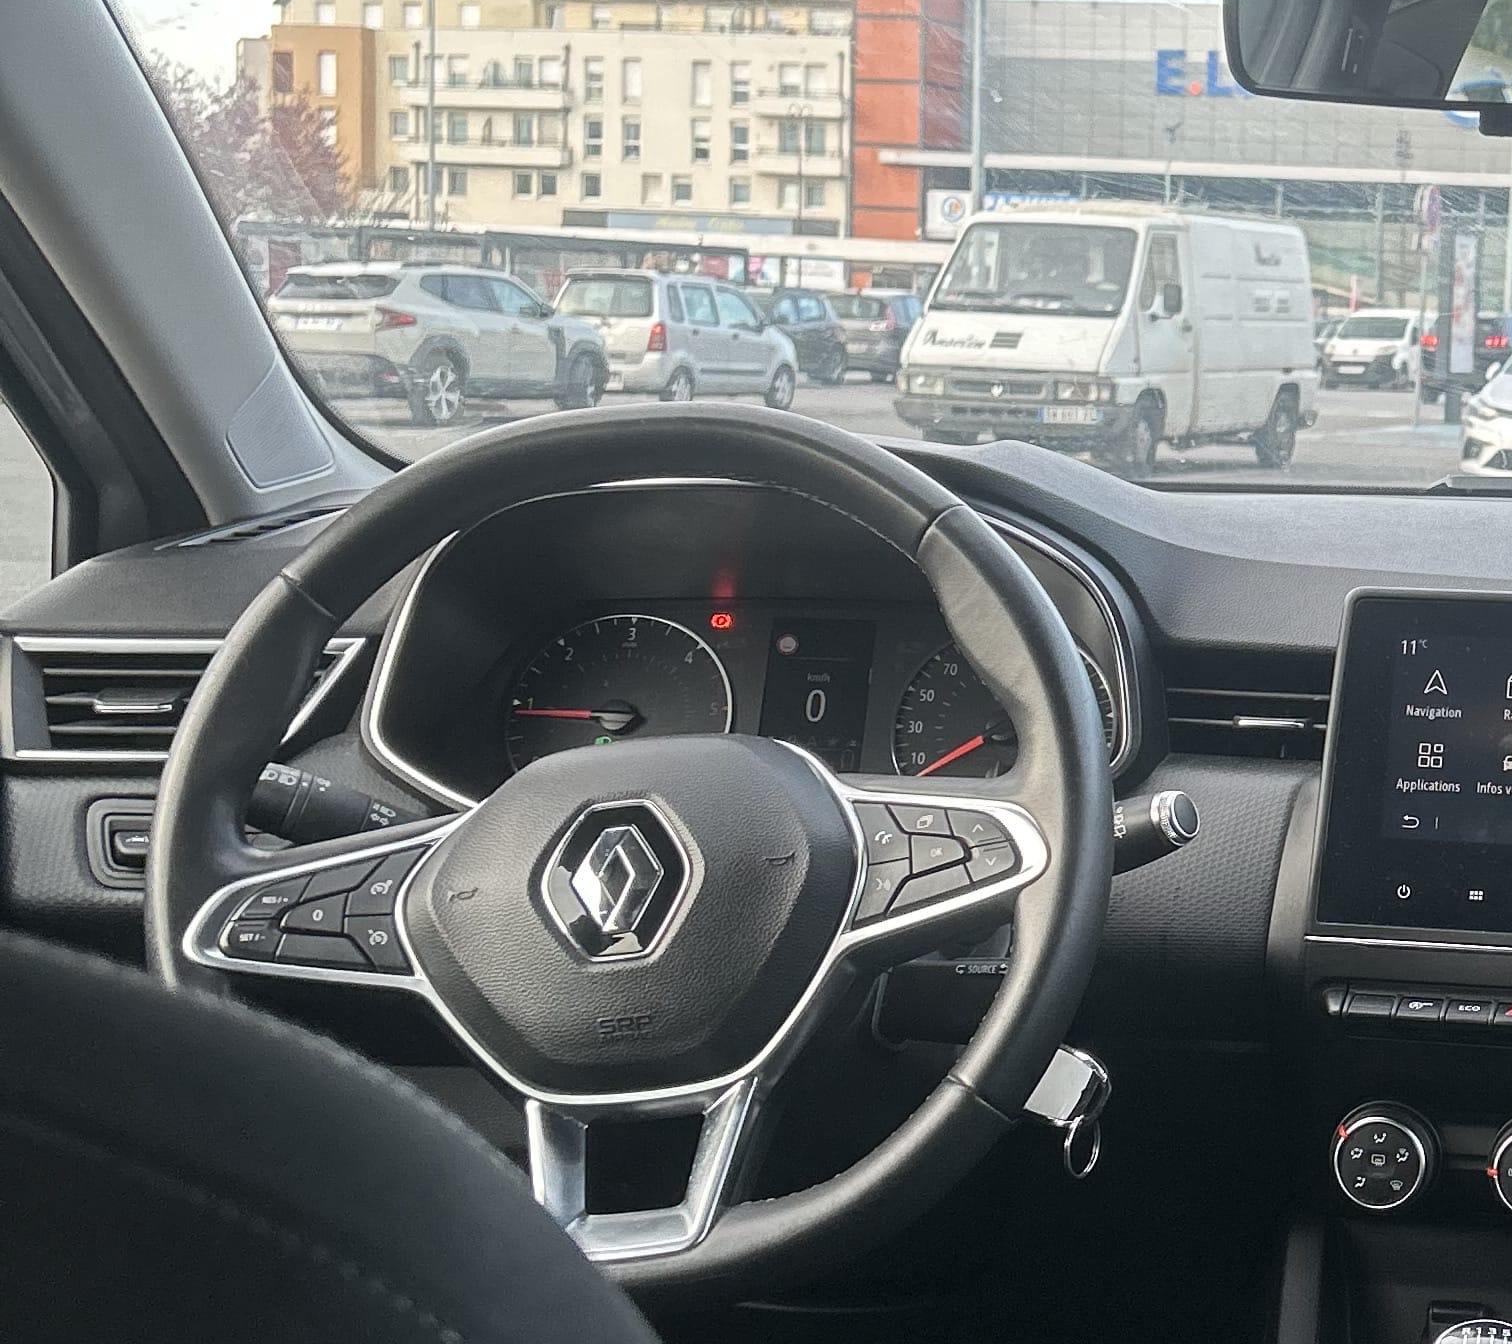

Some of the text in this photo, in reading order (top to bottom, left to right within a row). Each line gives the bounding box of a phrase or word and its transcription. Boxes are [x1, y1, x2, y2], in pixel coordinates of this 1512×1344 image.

[627, 628, 636, 641] 3
[564, 648, 574, 661] 2
[684, 652, 693, 664] 4
[943, 663, 958, 676] 70
[919, 689, 935, 702] 50
[805, 689, 827, 723] 0
[1406, 705, 1462, 721] Navigation
[908, 721, 923, 733] 30
[911, 752, 926, 765] 10
[1396, 779, 1461, 795] Applications
[1476, 781, 1503, 796] Infos
[967, 964, 998, 974] SOURCE
[1458, 1004, 1481, 1012] ECO
